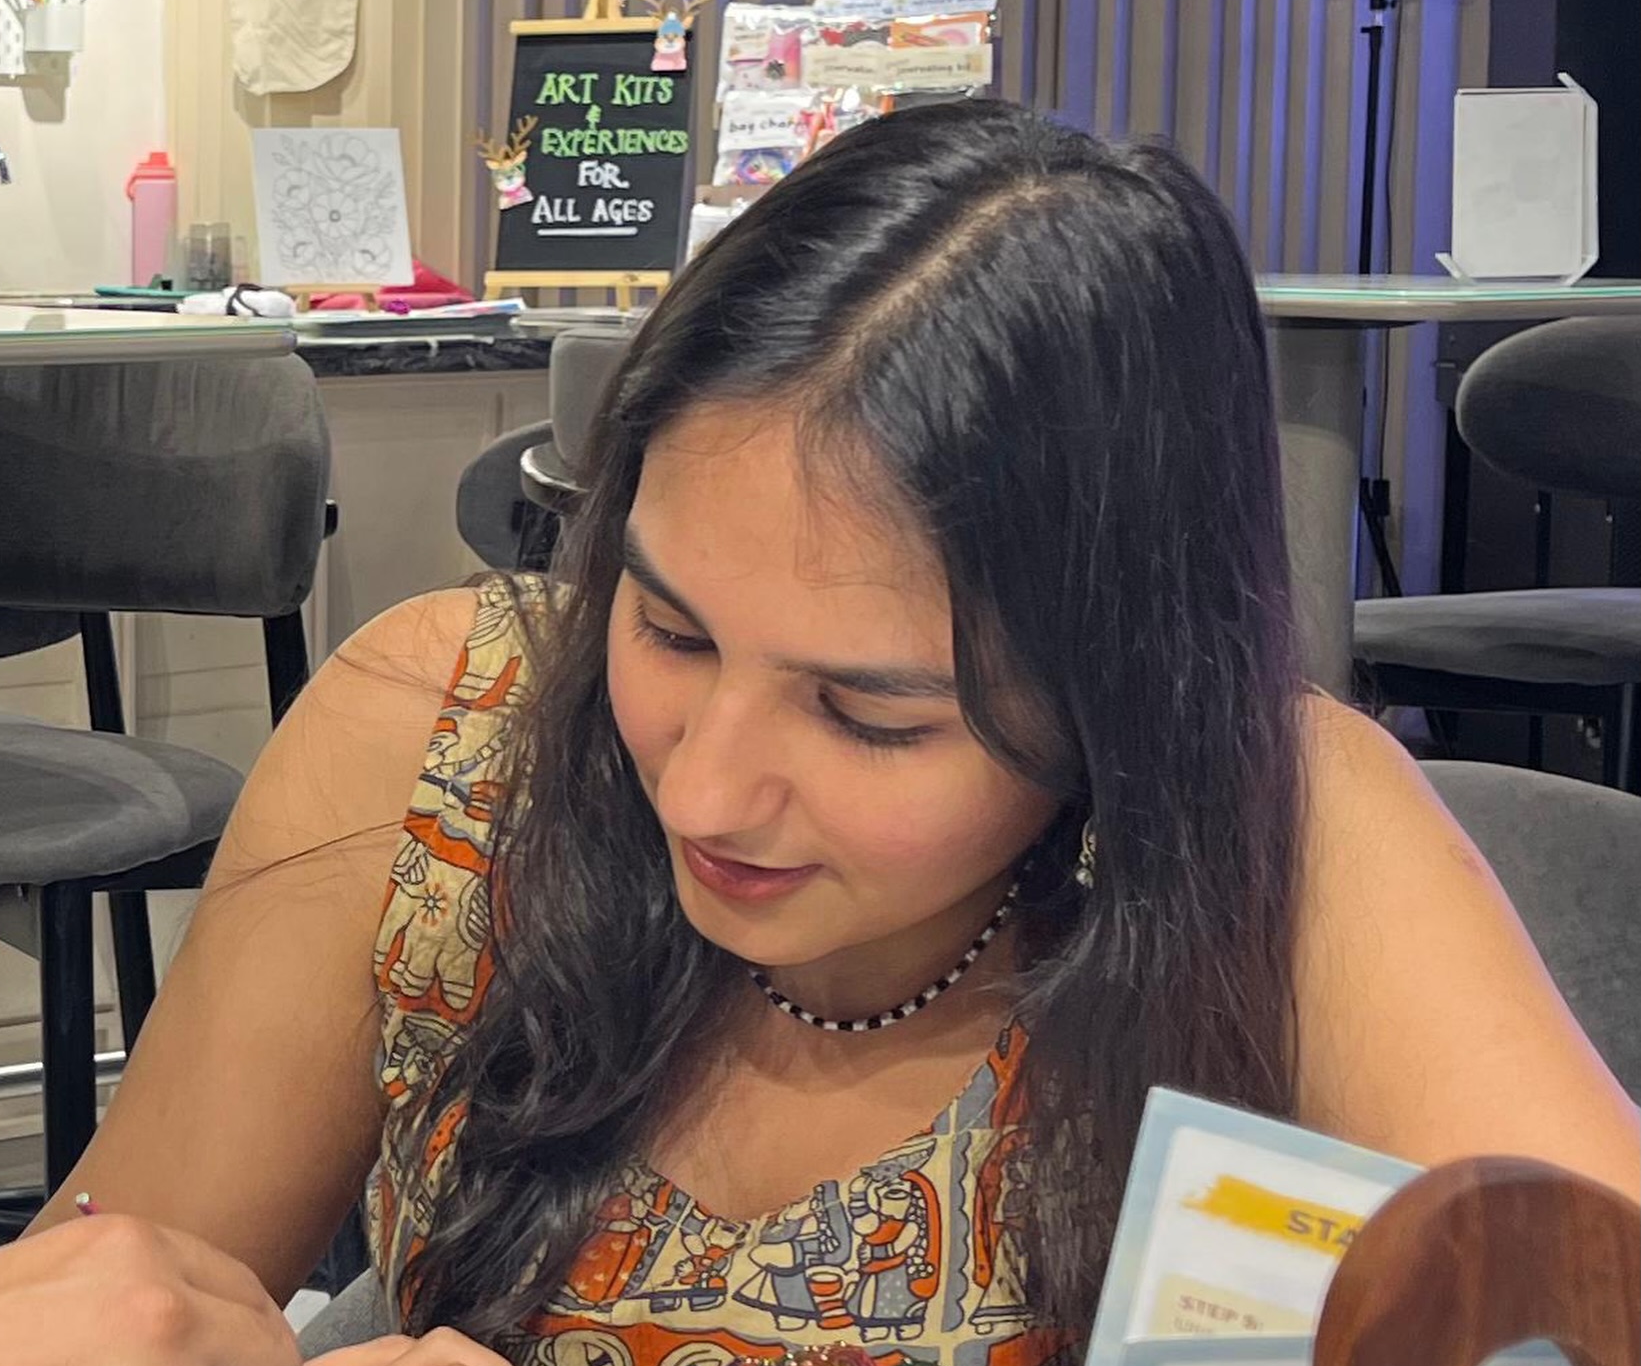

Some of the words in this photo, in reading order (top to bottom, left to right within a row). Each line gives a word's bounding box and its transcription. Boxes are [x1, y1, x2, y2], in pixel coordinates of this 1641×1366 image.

[534, 72, 600, 105] ART
[610, 72, 675, 107] KITS
[540, 127, 690, 158] EXPERIENCES
[577, 159, 631, 189] FOR
[531, 194, 582, 225] ALL
[590, 197, 655, 226] AGES
[1286, 1208, 1359, 1249] STA
